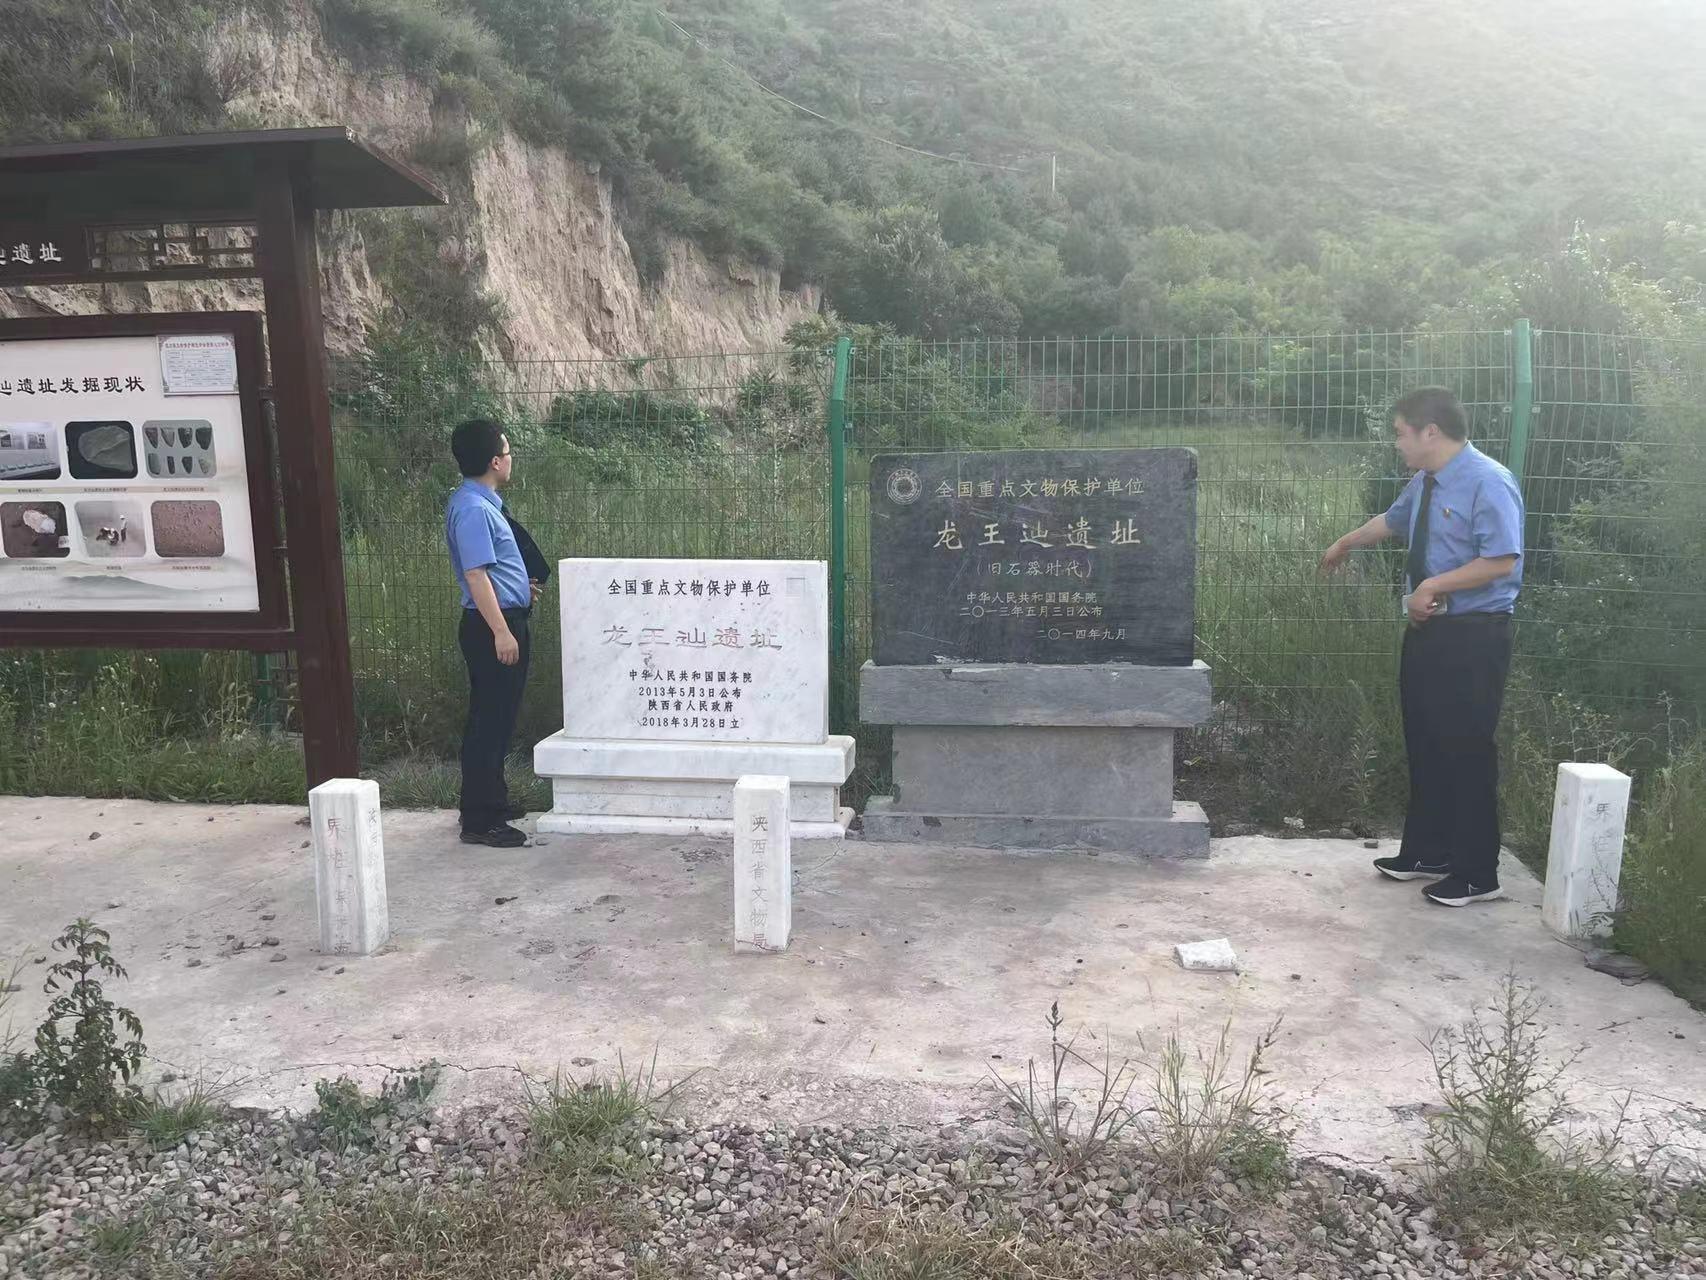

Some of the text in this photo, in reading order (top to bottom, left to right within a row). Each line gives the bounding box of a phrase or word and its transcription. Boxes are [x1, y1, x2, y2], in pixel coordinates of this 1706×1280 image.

[934, 478, 1145, 498] 全国重点文物保护单位
[933, 517, 1141, 550] 龙王辿遗址
[607, 578, 771, 597] 全国重点文物保护单位
[966, 592, 1097, 604] 中华人民共和国国务院
[601, 625, 783, 650] 龙王辿遗址
[629, 669, 753, 683] 中华人民共和国国务院
[638, 686, 742, 700] 2013年5月3日公布
[648, 699, 735, 712] 陕西省人民政府
[642, 716, 740, 729] 2018年3月28日立
